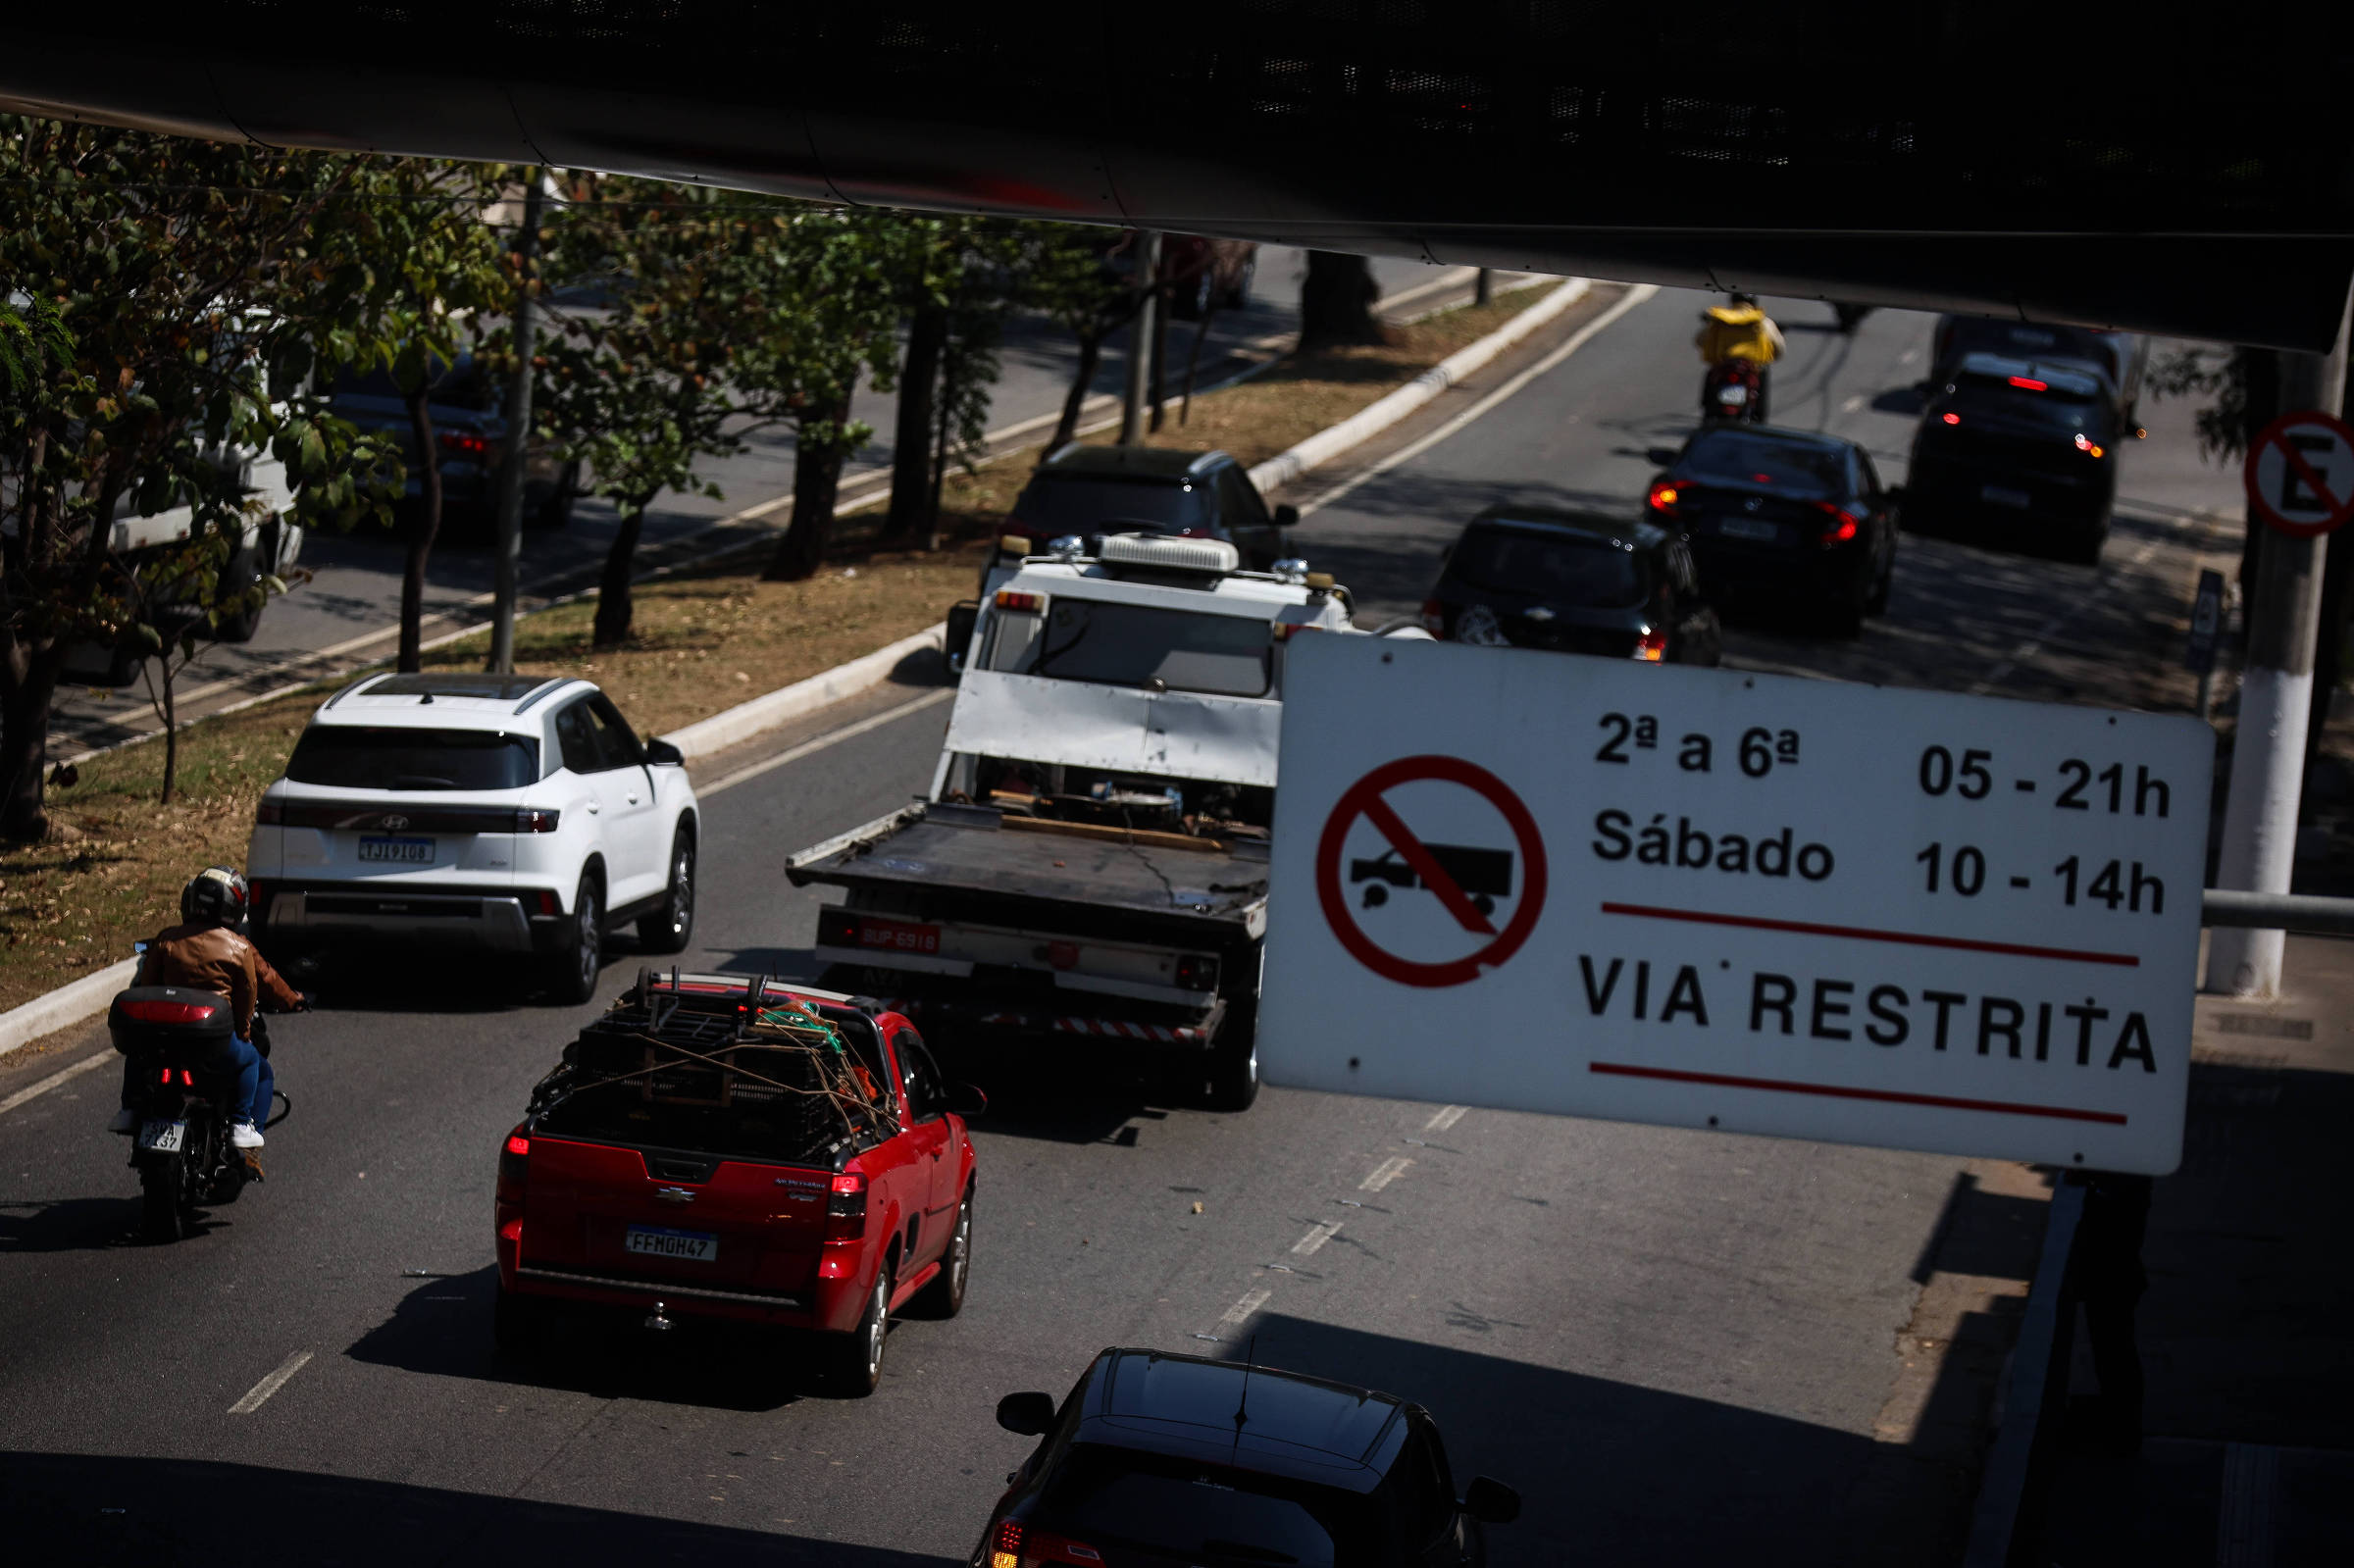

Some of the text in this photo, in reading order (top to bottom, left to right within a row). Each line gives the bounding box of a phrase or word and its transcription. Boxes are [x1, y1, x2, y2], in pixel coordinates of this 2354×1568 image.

[1595, 712, 2172, 821] 2ª a 6ª 05 - 21h
[1591, 808, 2166, 918] Sábado 10 - 14h
[1577, 954, 2159, 1076] VIA RESTRITA
